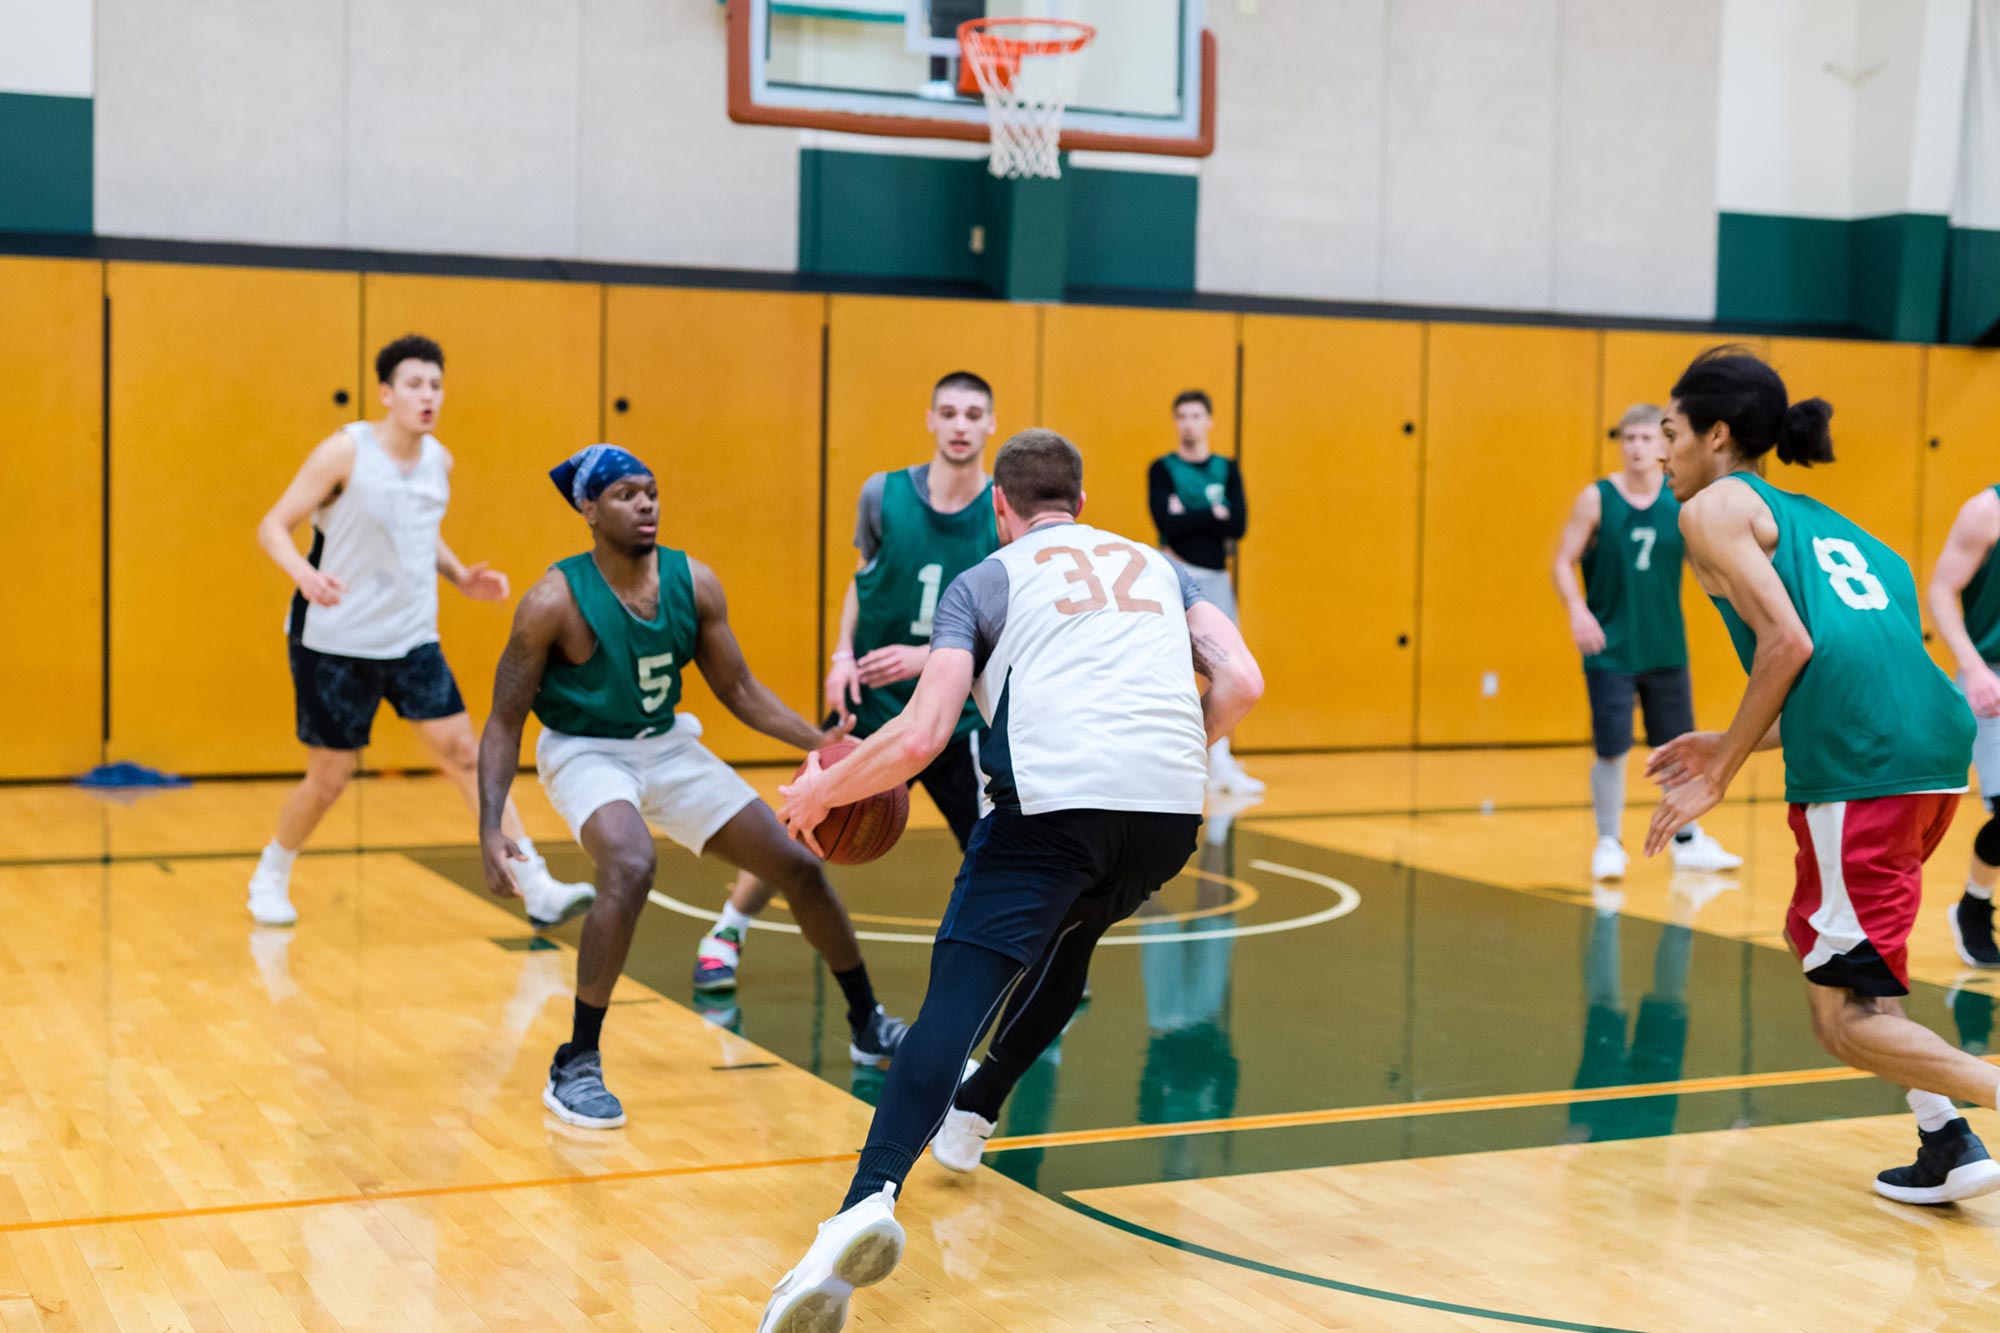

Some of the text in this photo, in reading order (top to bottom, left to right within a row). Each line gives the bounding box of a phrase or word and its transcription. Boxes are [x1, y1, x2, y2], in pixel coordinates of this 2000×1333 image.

[1034, 542, 1164, 615] 32
[1631, 526, 1657, 571] 7
[1812, 536, 1890, 611] 8
[638, 652, 673, 713] 5
